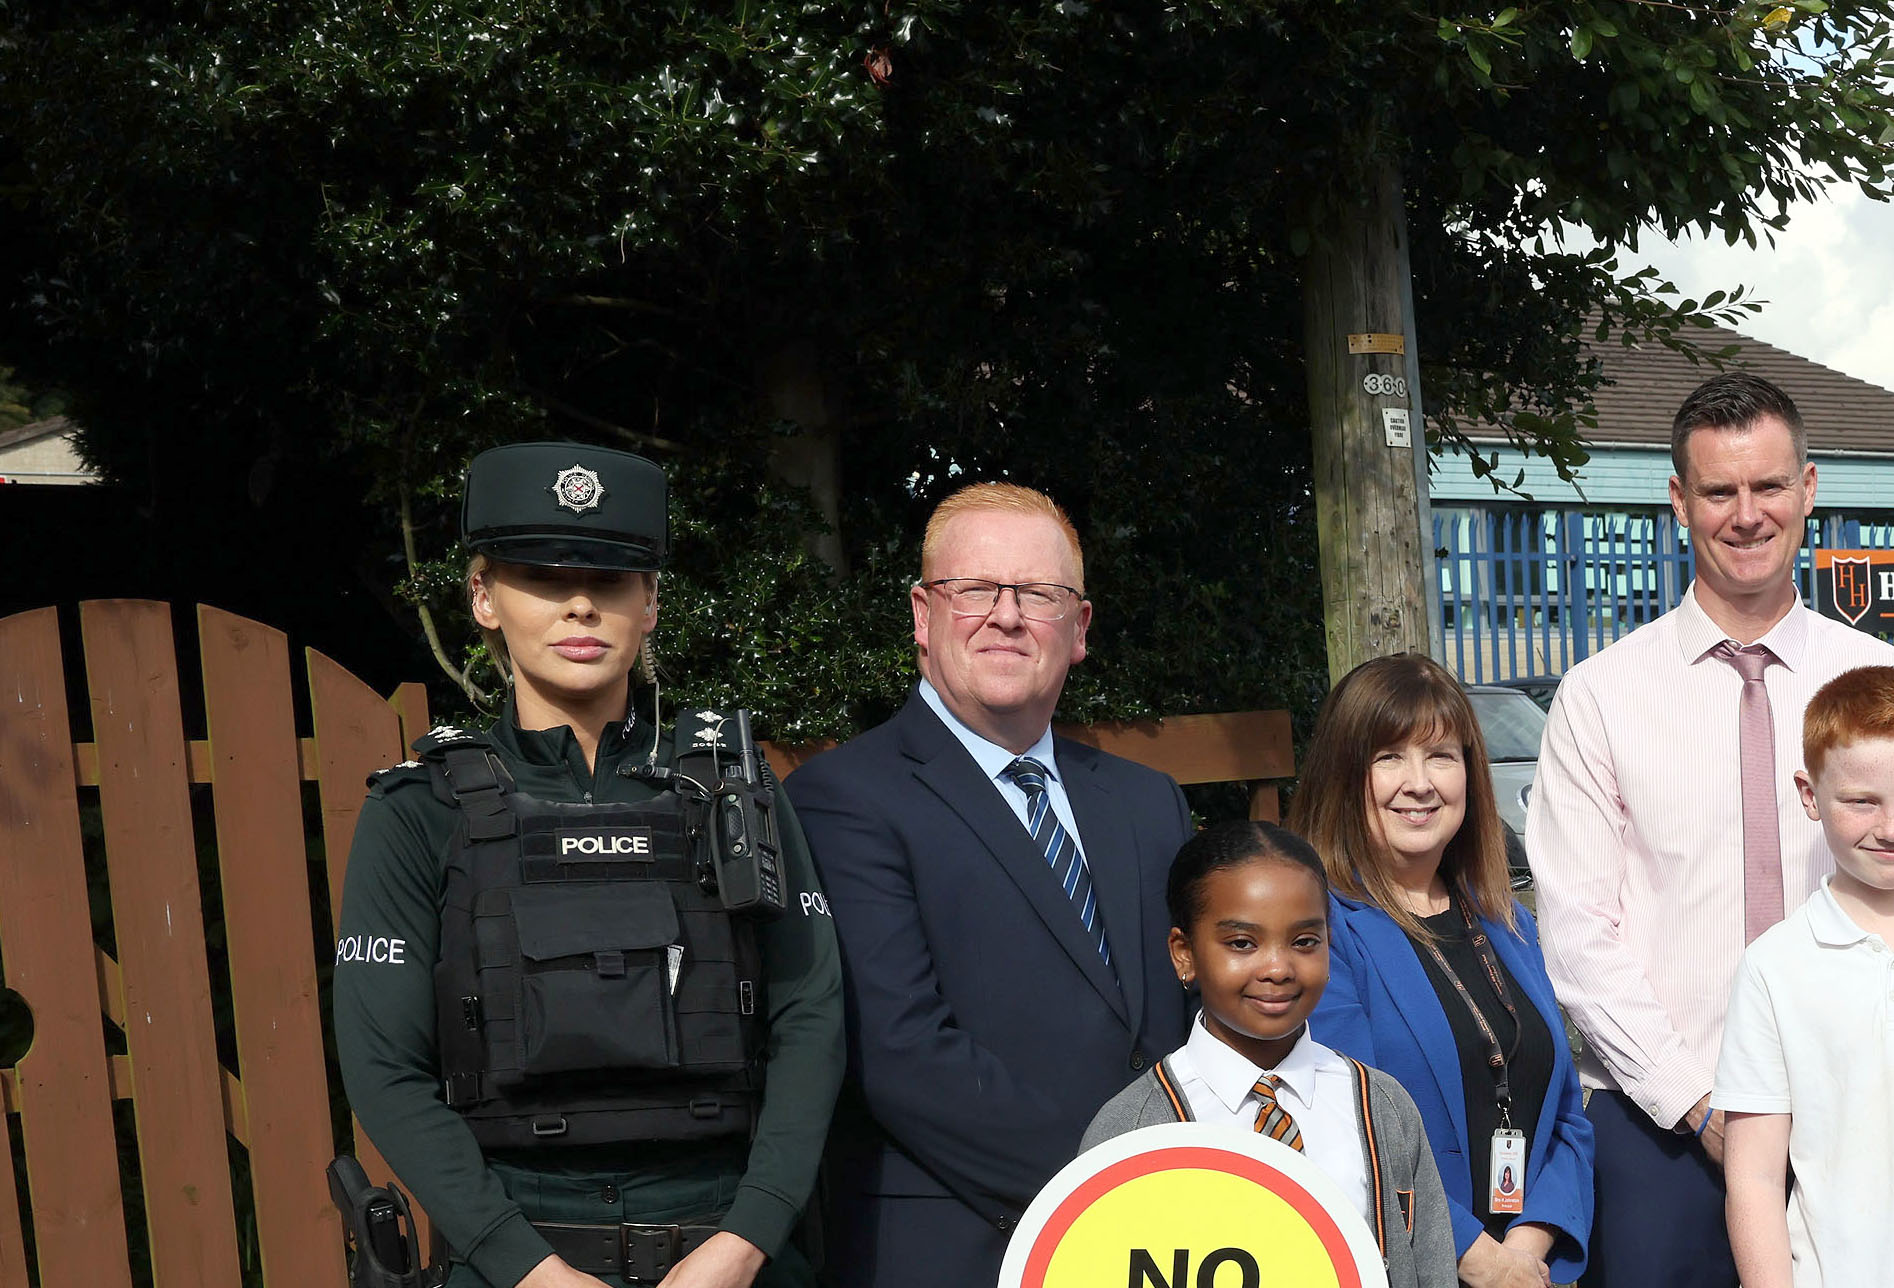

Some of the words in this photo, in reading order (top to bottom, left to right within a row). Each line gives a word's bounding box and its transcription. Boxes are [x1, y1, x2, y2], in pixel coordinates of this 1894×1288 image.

[1368, 376, 1405, 395] 360
[561, 836, 650, 855] POLICE
[335, 934, 406, 966] POLICE
